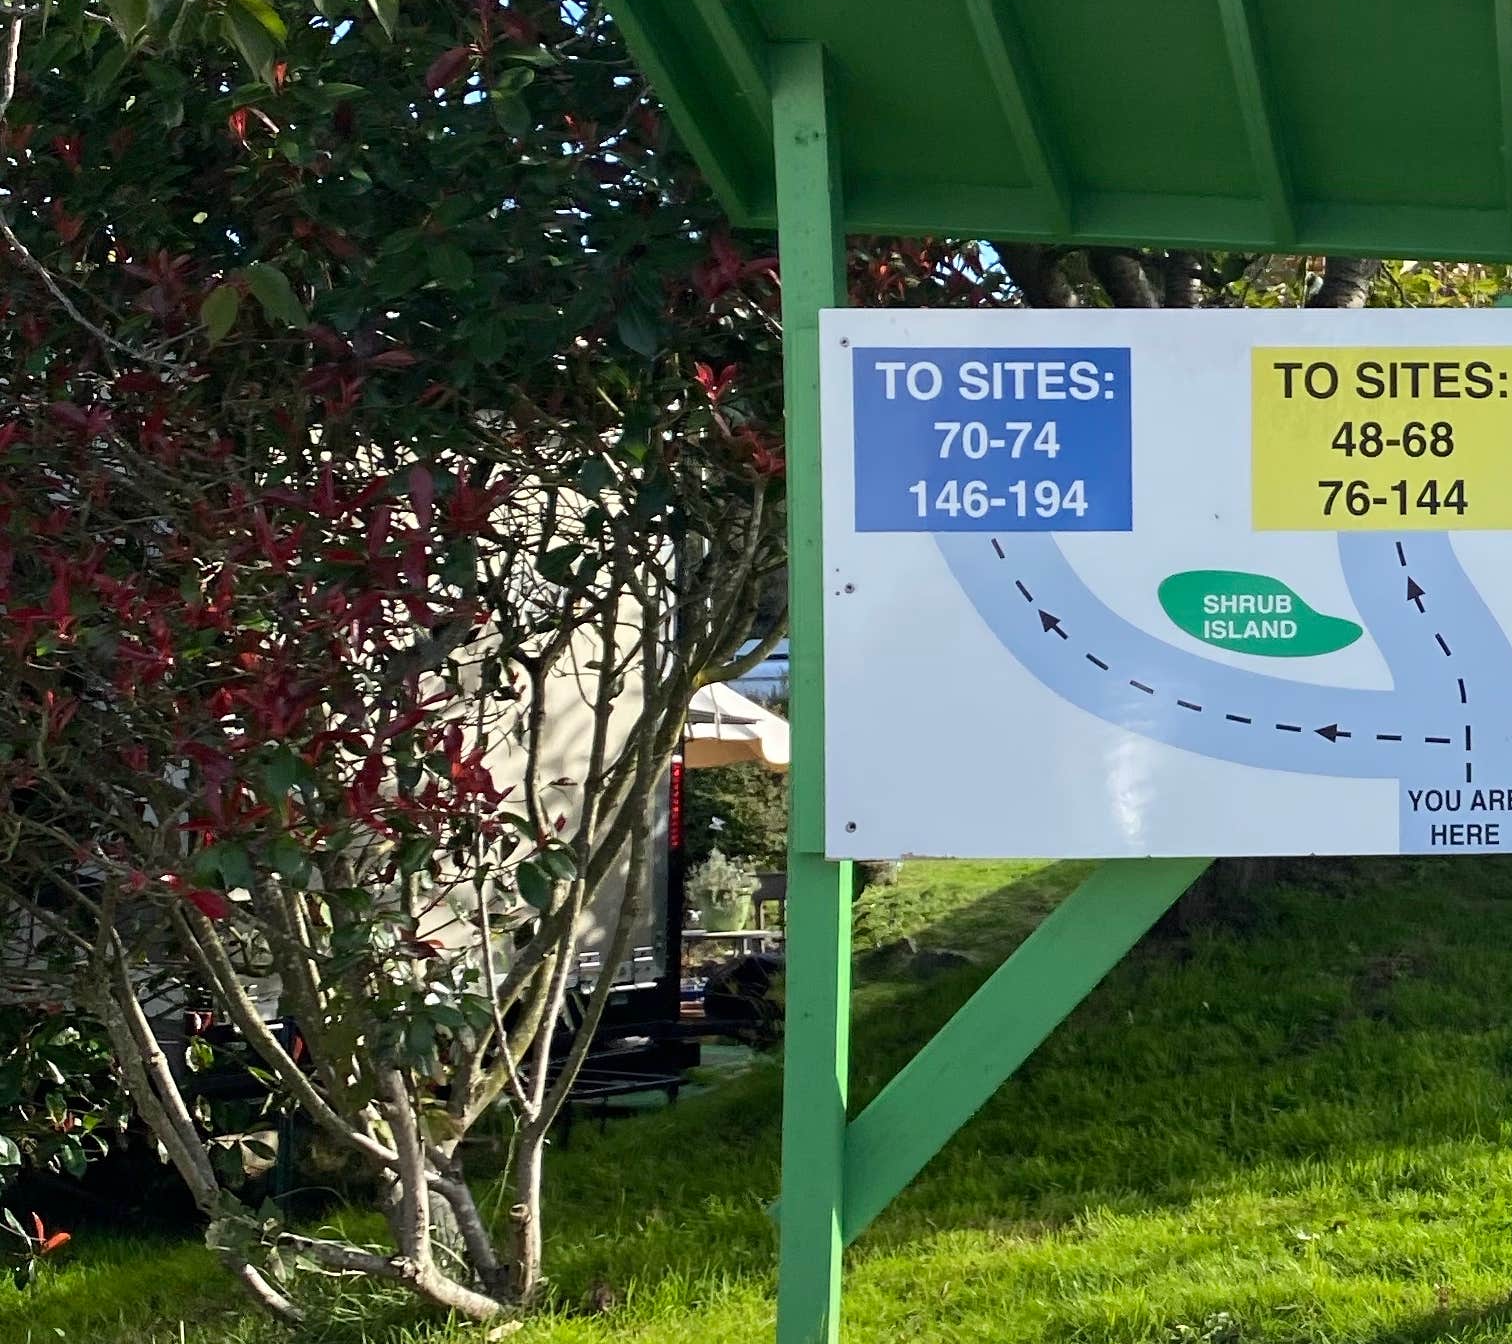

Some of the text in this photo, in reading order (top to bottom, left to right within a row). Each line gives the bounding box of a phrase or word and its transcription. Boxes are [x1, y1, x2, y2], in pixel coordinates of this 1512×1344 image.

[875, 361, 1116, 400] TO SITES:
[1273, 361, 1509, 399] TO SITES:
[934, 422, 1060, 458] 70-74
[1331, 422, 1455, 458] 48-68
[909, 481, 1088, 518] 146-194
[1318, 480, 1469, 516] 76-144
[1202, 594, 1293, 616] SHRUB
[1202, 619, 1298, 640] ISLAND
[1408, 789, 1462, 813] YOU
[1430, 823, 1500, 846] HERE
